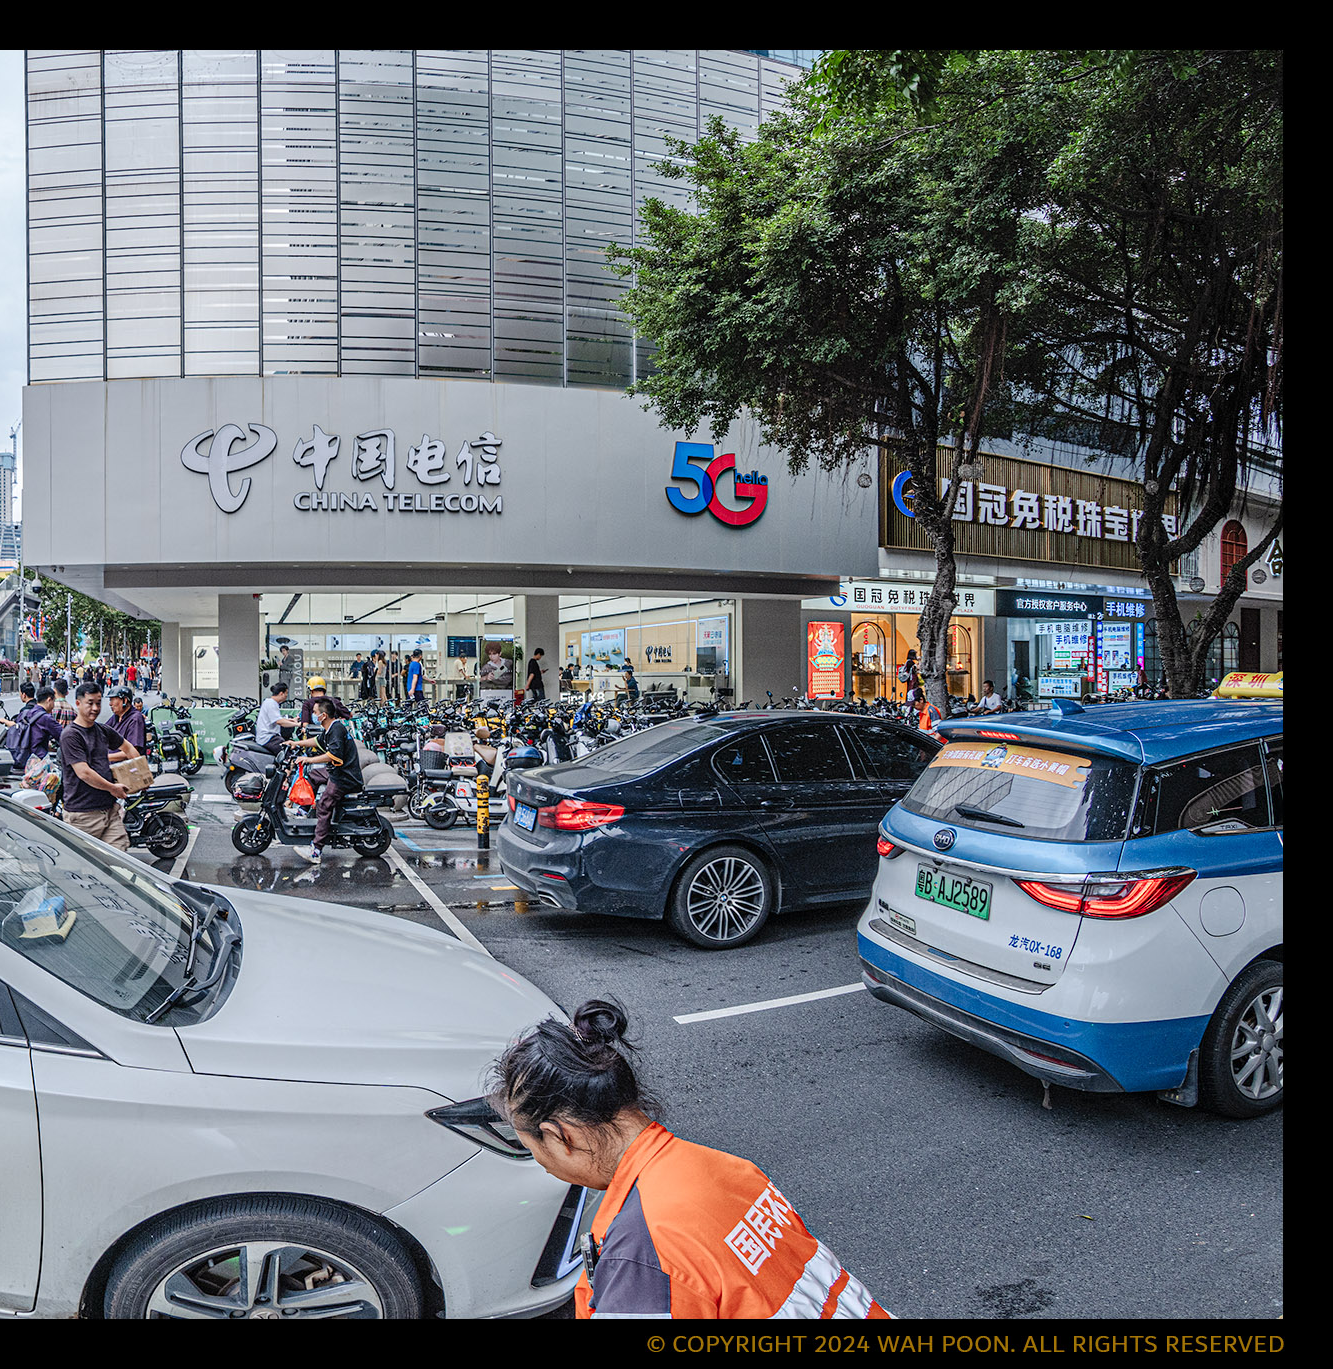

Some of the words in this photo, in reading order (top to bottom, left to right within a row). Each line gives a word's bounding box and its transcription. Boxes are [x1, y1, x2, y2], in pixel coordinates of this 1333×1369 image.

[292, 424, 503, 491] 中国电信
[665, 440, 769, 529] 5G
[733, 468, 769, 486] hello
[293, 492, 378, 511] CHINA
[383, 493, 503, 514] TELECOM
[1016, 598, 1087, 612] 官方授权客户服务中心
[1106, 602, 1145, 617] 手机维修
[1038, 623, 1089, 633] 手机电脑维修
[1055, 634, 1088, 645] 手机维修
[1227, 672, 1269, 689] 深圳
[560, 691, 584, 705] Find
[587, 692, 605, 704] X8
[935, 832, 950, 845] BYD
